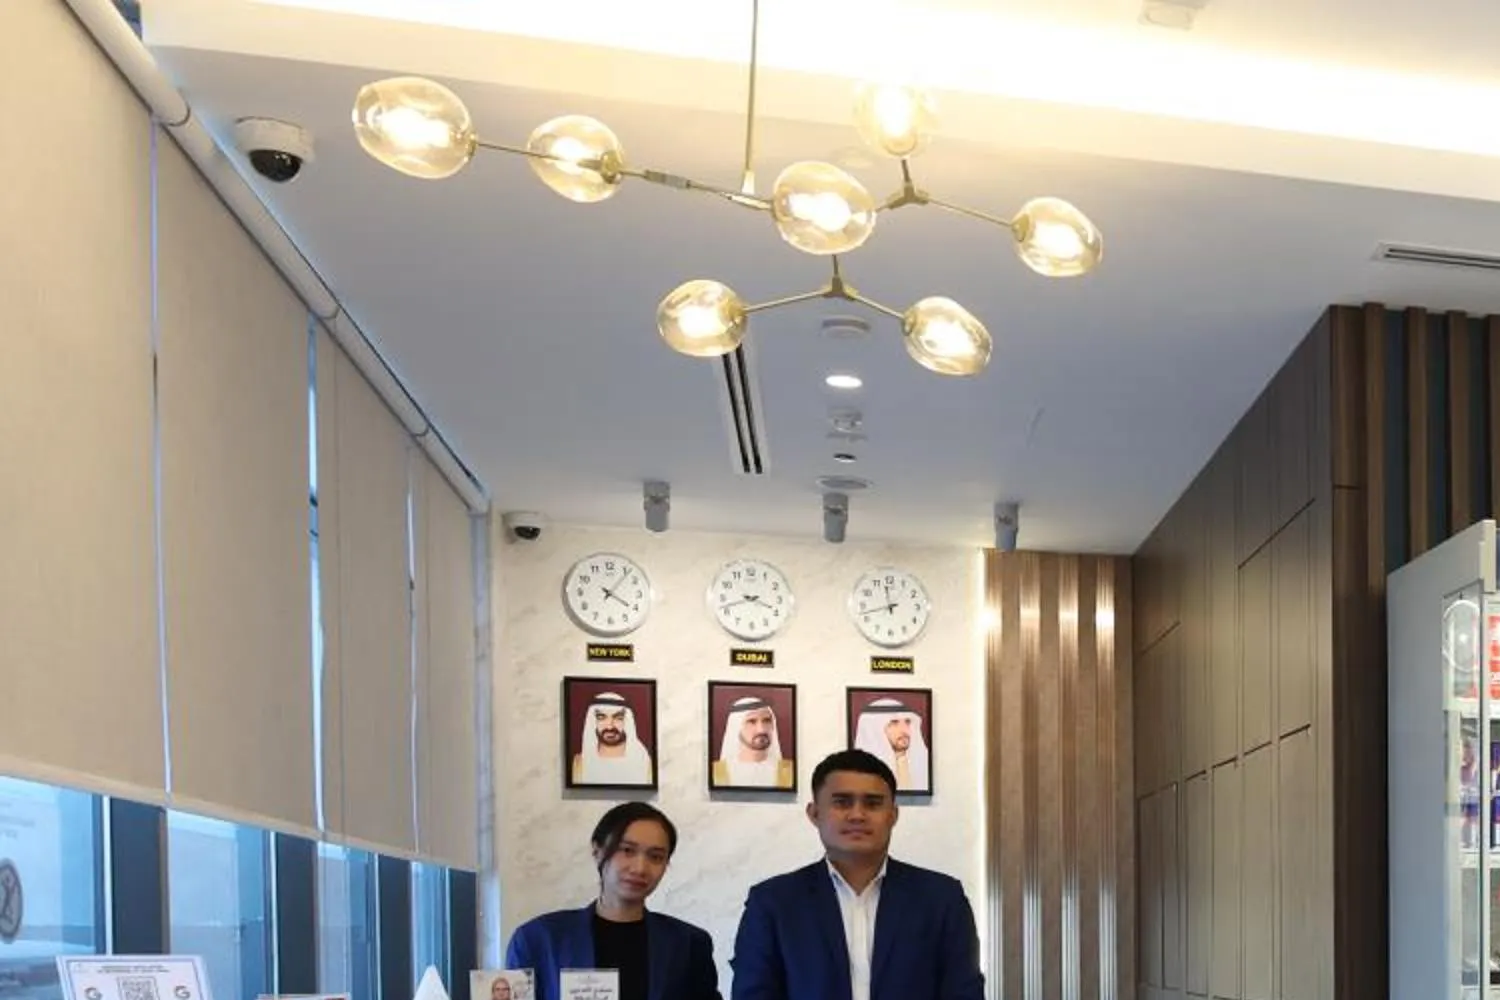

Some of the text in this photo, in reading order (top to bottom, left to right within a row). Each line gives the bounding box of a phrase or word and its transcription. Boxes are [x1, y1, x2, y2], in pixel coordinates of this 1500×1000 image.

[589, 647, 631, 657] NEW YORK
[735, 653, 768, 662] DUBAI
[873, 660, 911, 669] LONDON
[174, 985, 191, 1000] G
